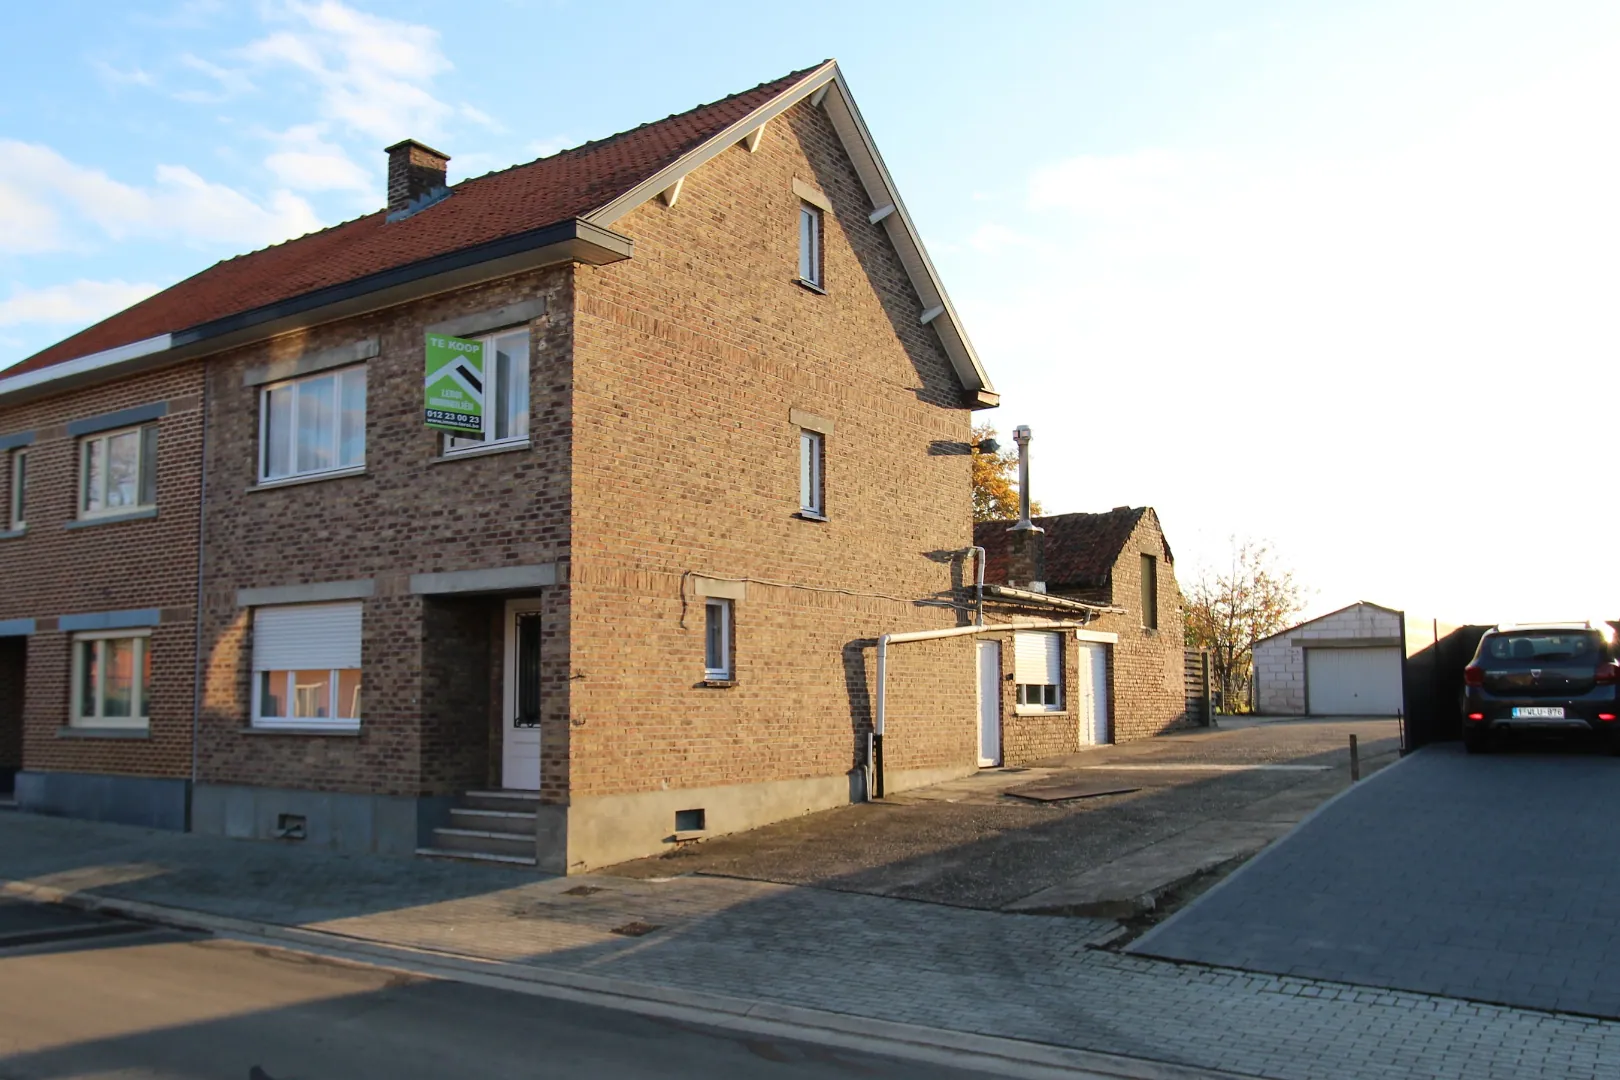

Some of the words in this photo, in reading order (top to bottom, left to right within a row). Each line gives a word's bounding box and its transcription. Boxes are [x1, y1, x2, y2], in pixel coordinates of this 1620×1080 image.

[430, 337, 445, 348] TE
[448, 340, 480, 353] KOOP
[427, 410, 443, 419] 012
[444, 412, 455, 420] 23
[457, 414, 468, 422] 00
[469, 415, 480, 424] 23
